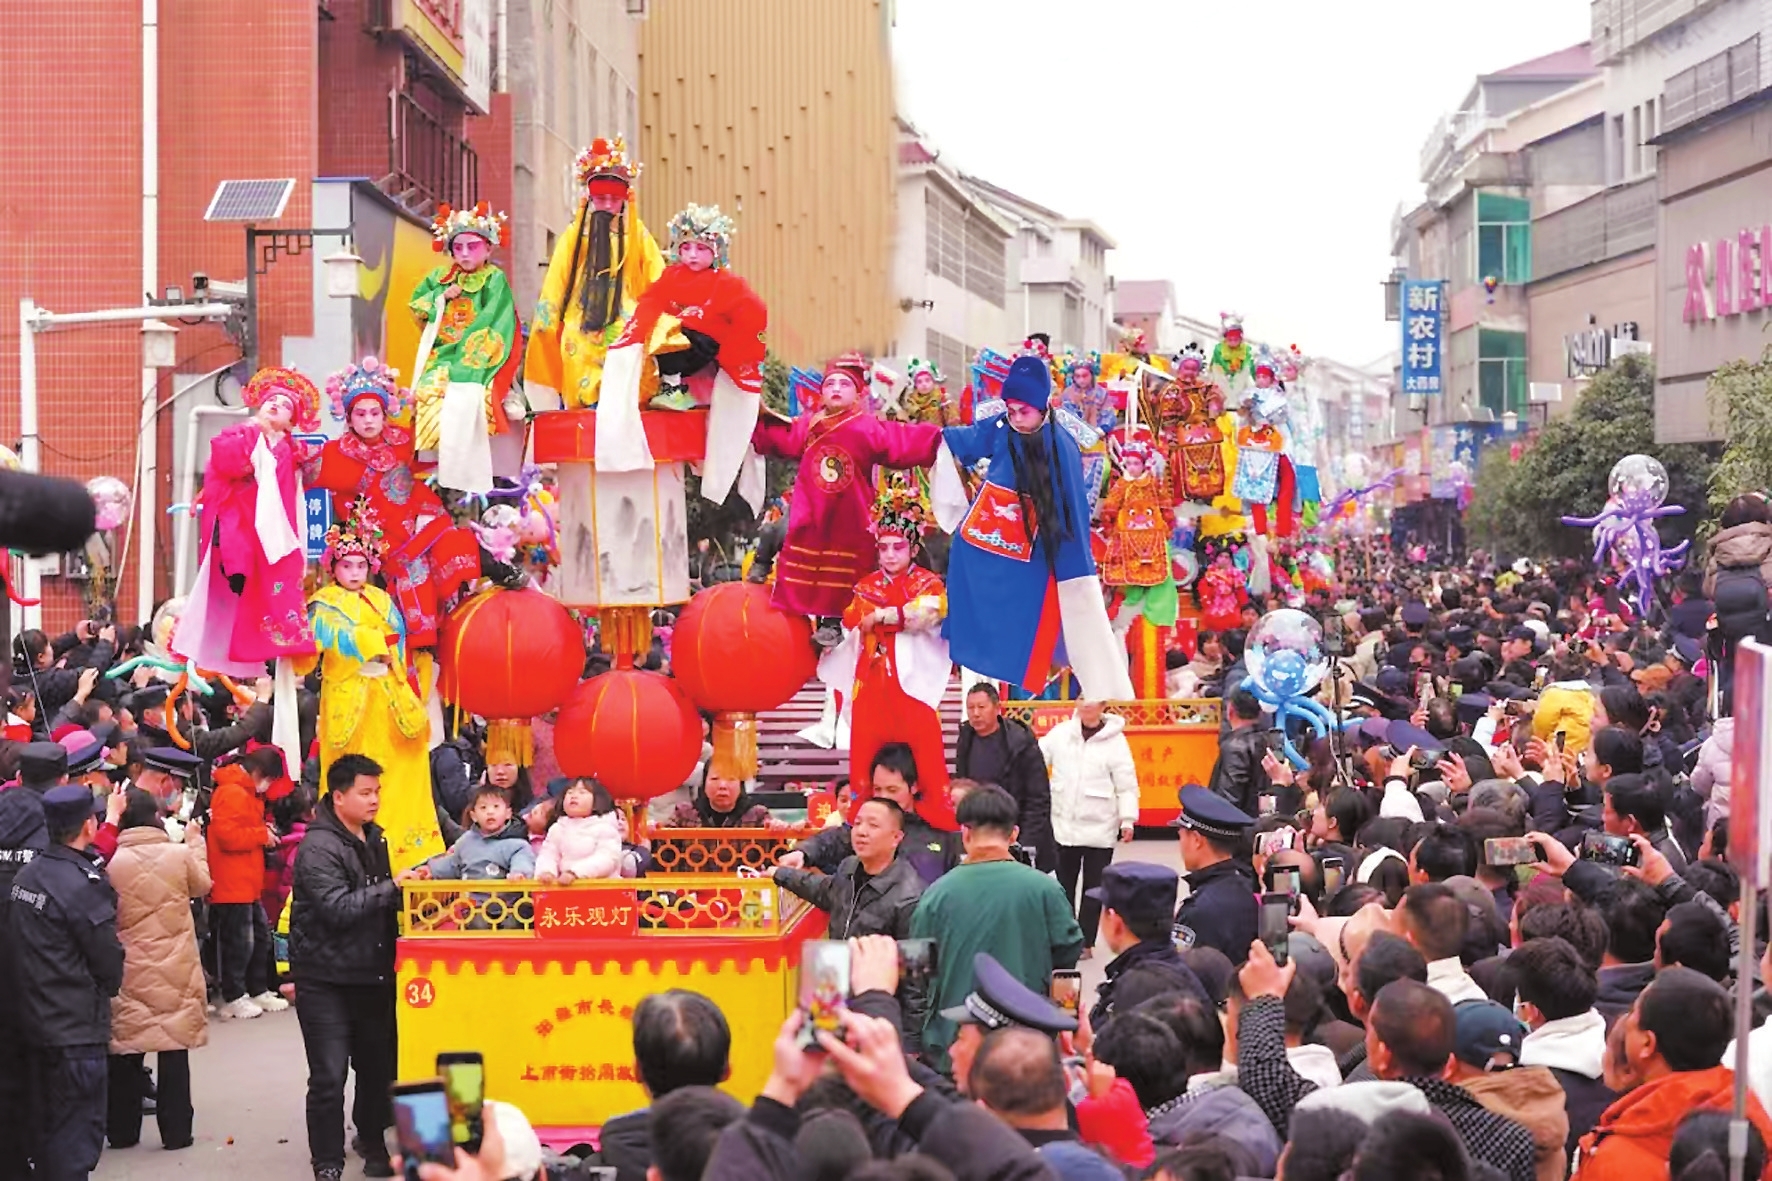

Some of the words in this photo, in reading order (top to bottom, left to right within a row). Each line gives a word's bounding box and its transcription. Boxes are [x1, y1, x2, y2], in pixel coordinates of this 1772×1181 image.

[1409, 286, 1438, 369] 新农村
[539, 905, 632, 928] 永乐观灯
[408, 983, 433, 1004] 34
